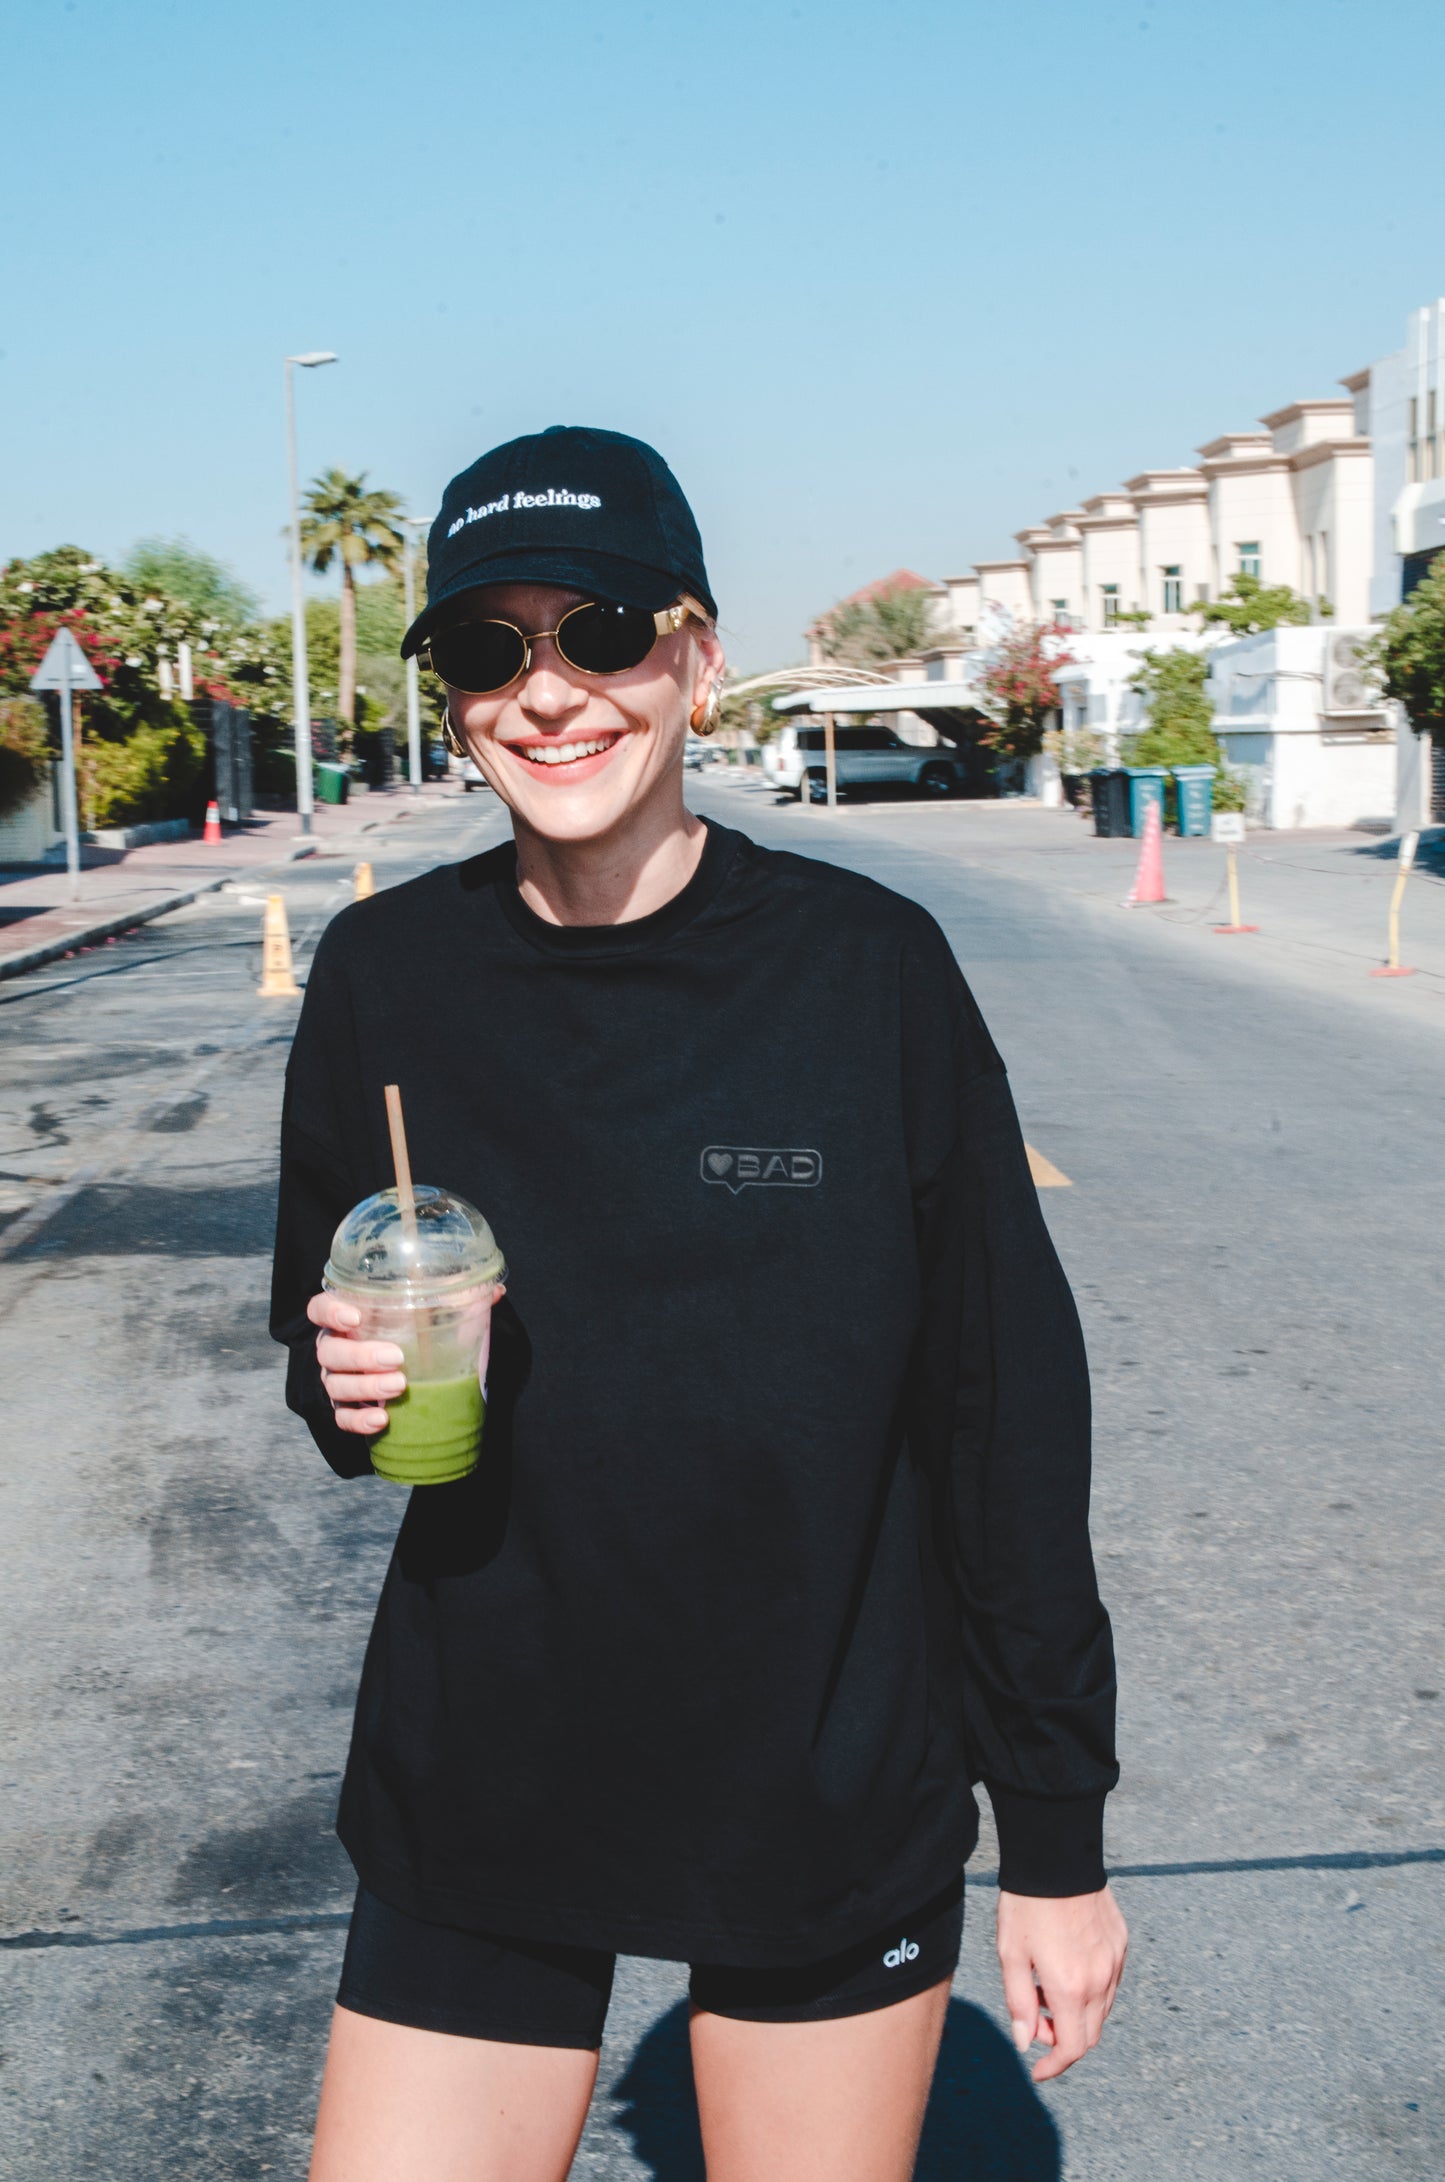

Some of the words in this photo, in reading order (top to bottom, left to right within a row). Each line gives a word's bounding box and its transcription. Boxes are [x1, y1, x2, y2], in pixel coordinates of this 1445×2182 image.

[447, 517, 465, 538] no
[465, 494, 510, 524] hard
[512, 488, 602, 510] feelings
[737, 1153, 815, 1179] BAD
[882, 1937, 920, 1968] alo
